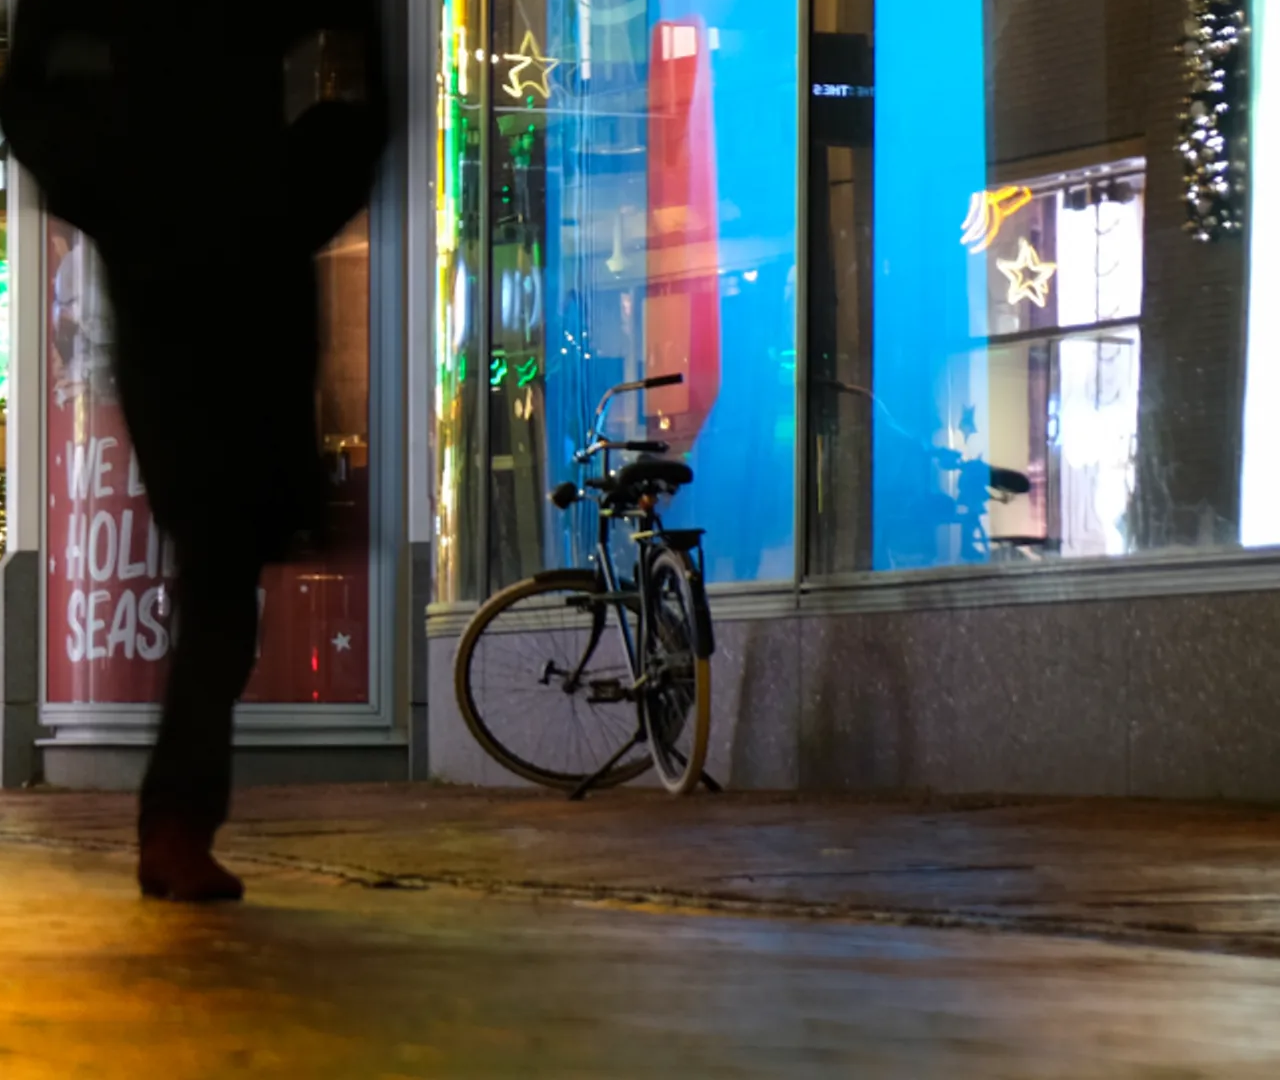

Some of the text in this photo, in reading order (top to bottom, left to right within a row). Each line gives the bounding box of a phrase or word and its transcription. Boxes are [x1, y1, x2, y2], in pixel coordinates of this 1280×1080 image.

[65, 435, 118, 500] WE
[65, 509, 176, 582] HOLI
[66, 584, 178, 663] SEAS
